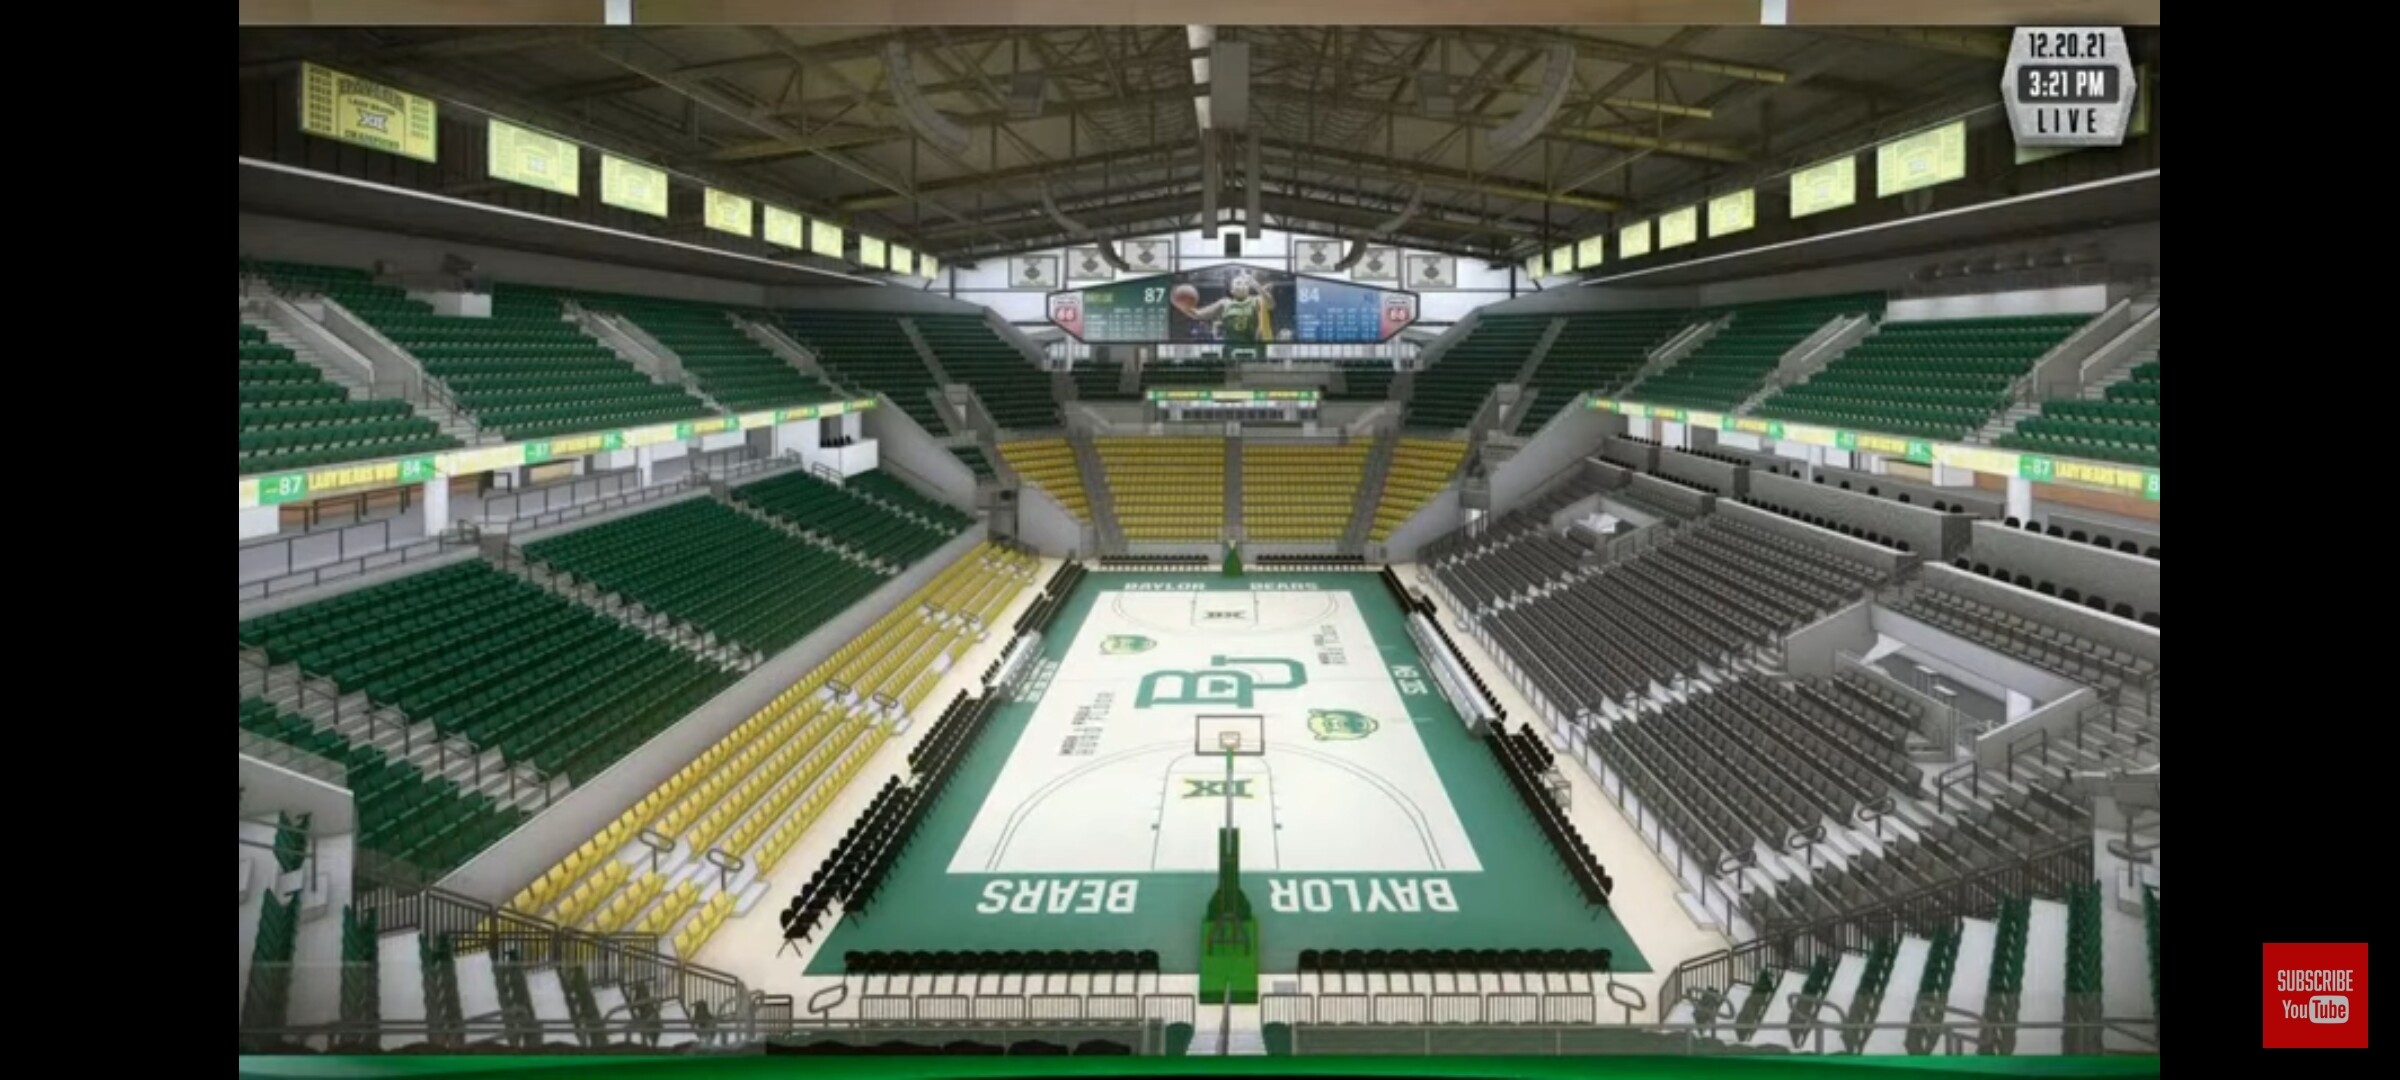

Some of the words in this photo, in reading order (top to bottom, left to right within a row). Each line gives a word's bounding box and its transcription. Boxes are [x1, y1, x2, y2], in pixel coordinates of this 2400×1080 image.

[1144, 287, 1166, 303] 87
[1299, 287, 1320, 303] 84
[2033, 459, 2050, 476] 87
[279, 475, 302, 496] 87
[402, 460, 421, 477] 84
[1123, 581, 1206, 592] BAYLOR
[1250, 581, 1319, 592] BEARS
[976, 878, 1139, 915] BEARS
[1269, 878, 1460, 914] BAYLOR
